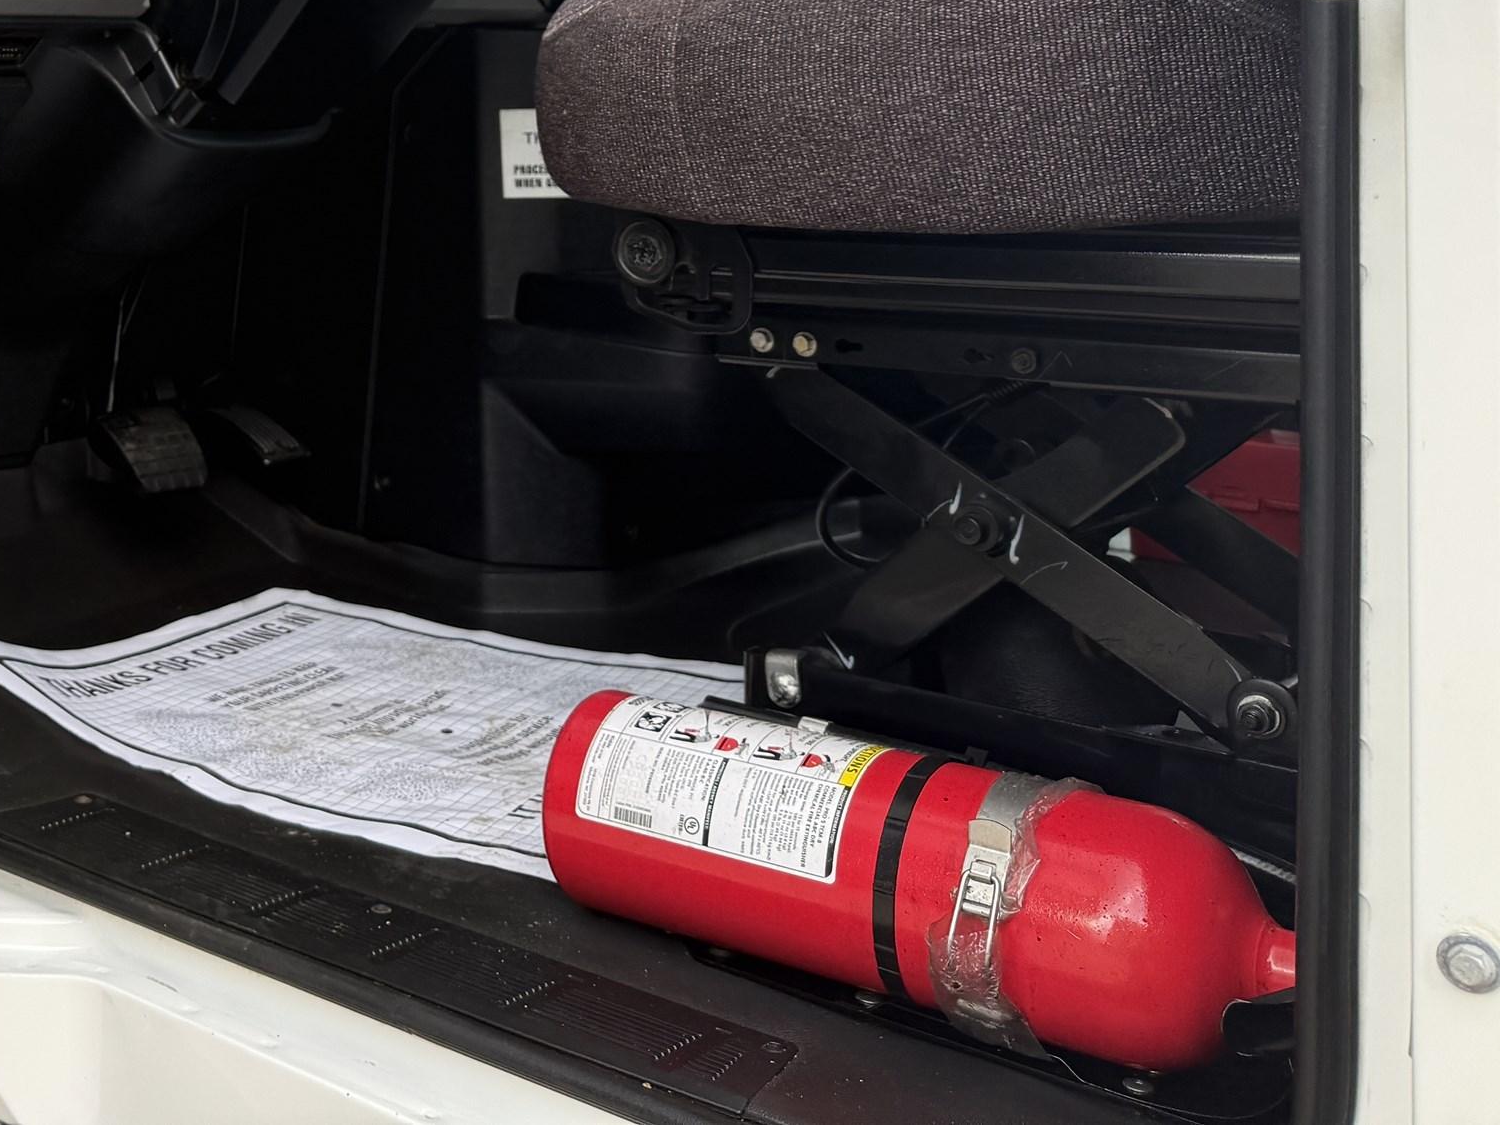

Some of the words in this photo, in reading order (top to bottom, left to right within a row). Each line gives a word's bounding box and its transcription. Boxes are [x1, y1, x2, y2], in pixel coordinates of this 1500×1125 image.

[39, 671, 152, 697] THANKS
[138, 656, 206, 675] FOR
[191, 623, 293, 660] COMING
[277, 613, 321, 627] IN
[809, 783, 822, 809] CHEMICAL
[814, 785, 829, 820] COMMERCIAL
[800, 823, 810, 867] EXTINGUISHER
